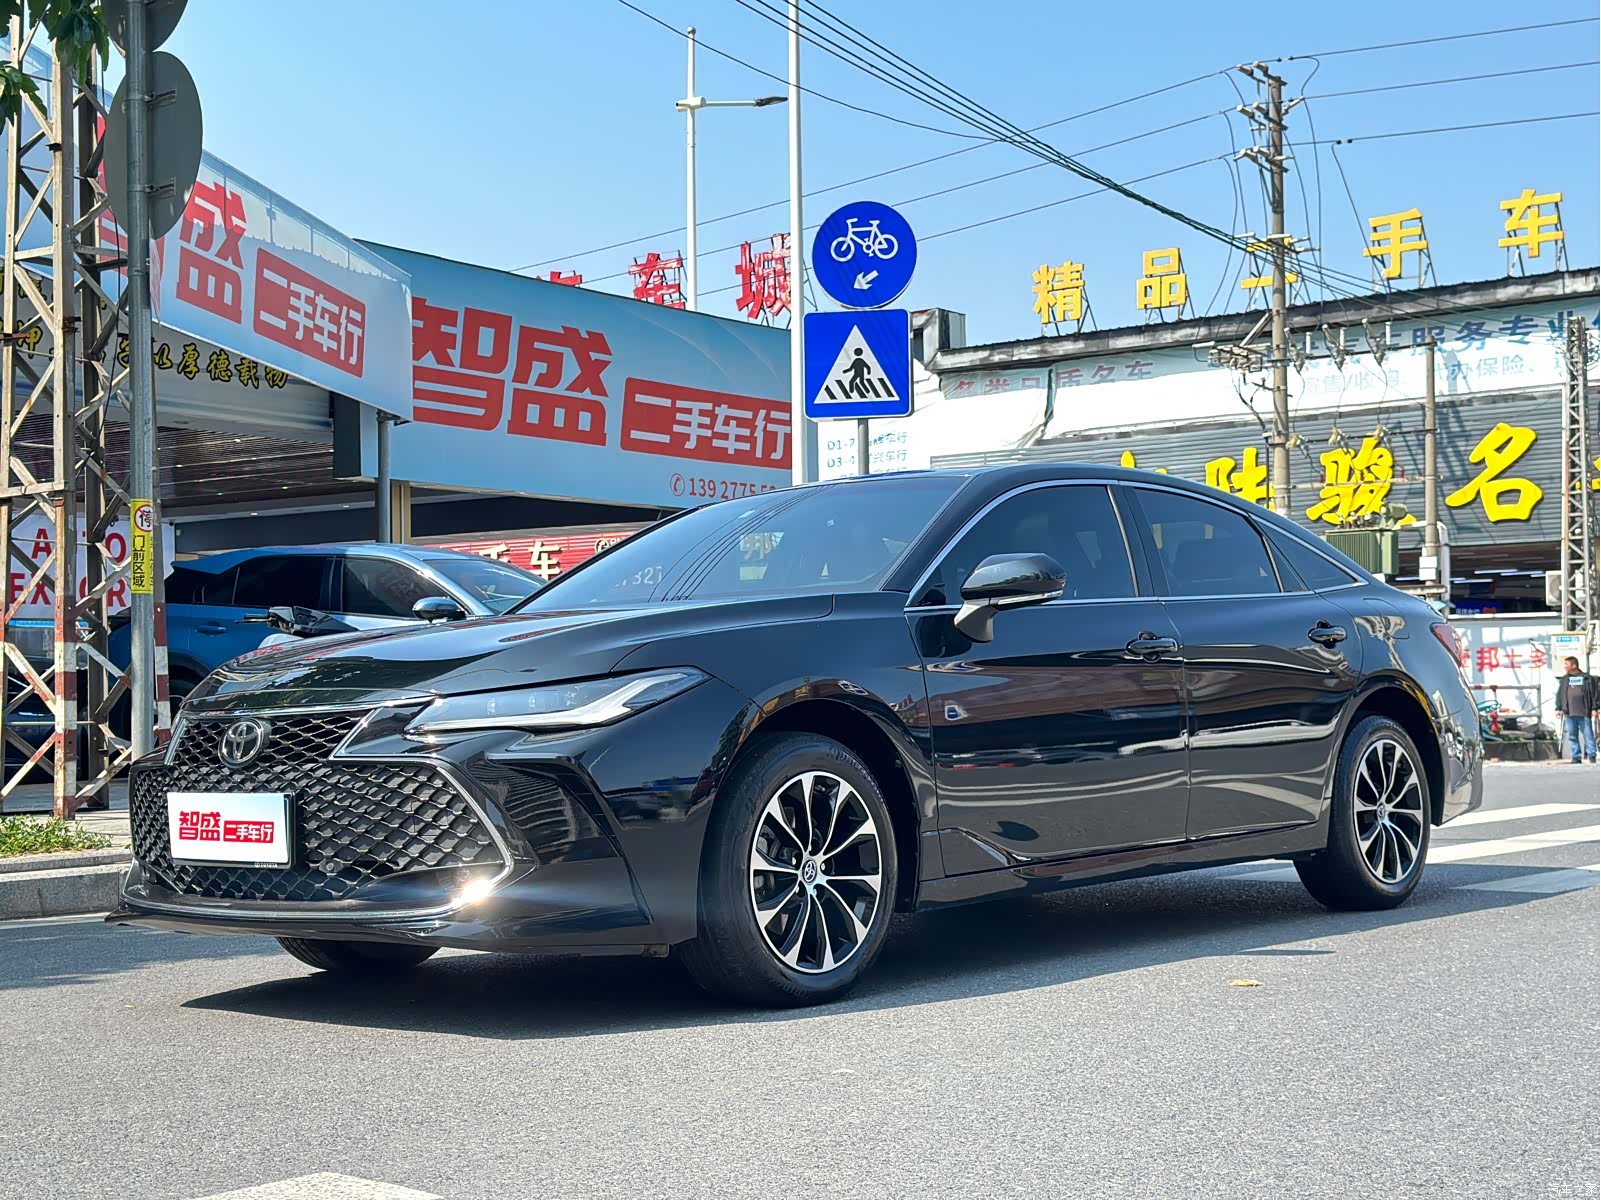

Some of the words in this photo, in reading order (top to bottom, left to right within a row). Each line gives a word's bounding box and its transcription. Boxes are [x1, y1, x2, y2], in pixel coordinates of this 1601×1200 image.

[1032, 189, 1563, 325] 精品二手车
[259, 268, 364, 366] 二手车行
[412, 296, 613, 447] 智盛
[629, 393, 791, 460] 二手车行
[689, 477, 717, 498] 139
[132, 534, 146, 588] 门前区域
[178, 810, 221, 841] 智盛
[225, 823, 273, 841] 二手车行
